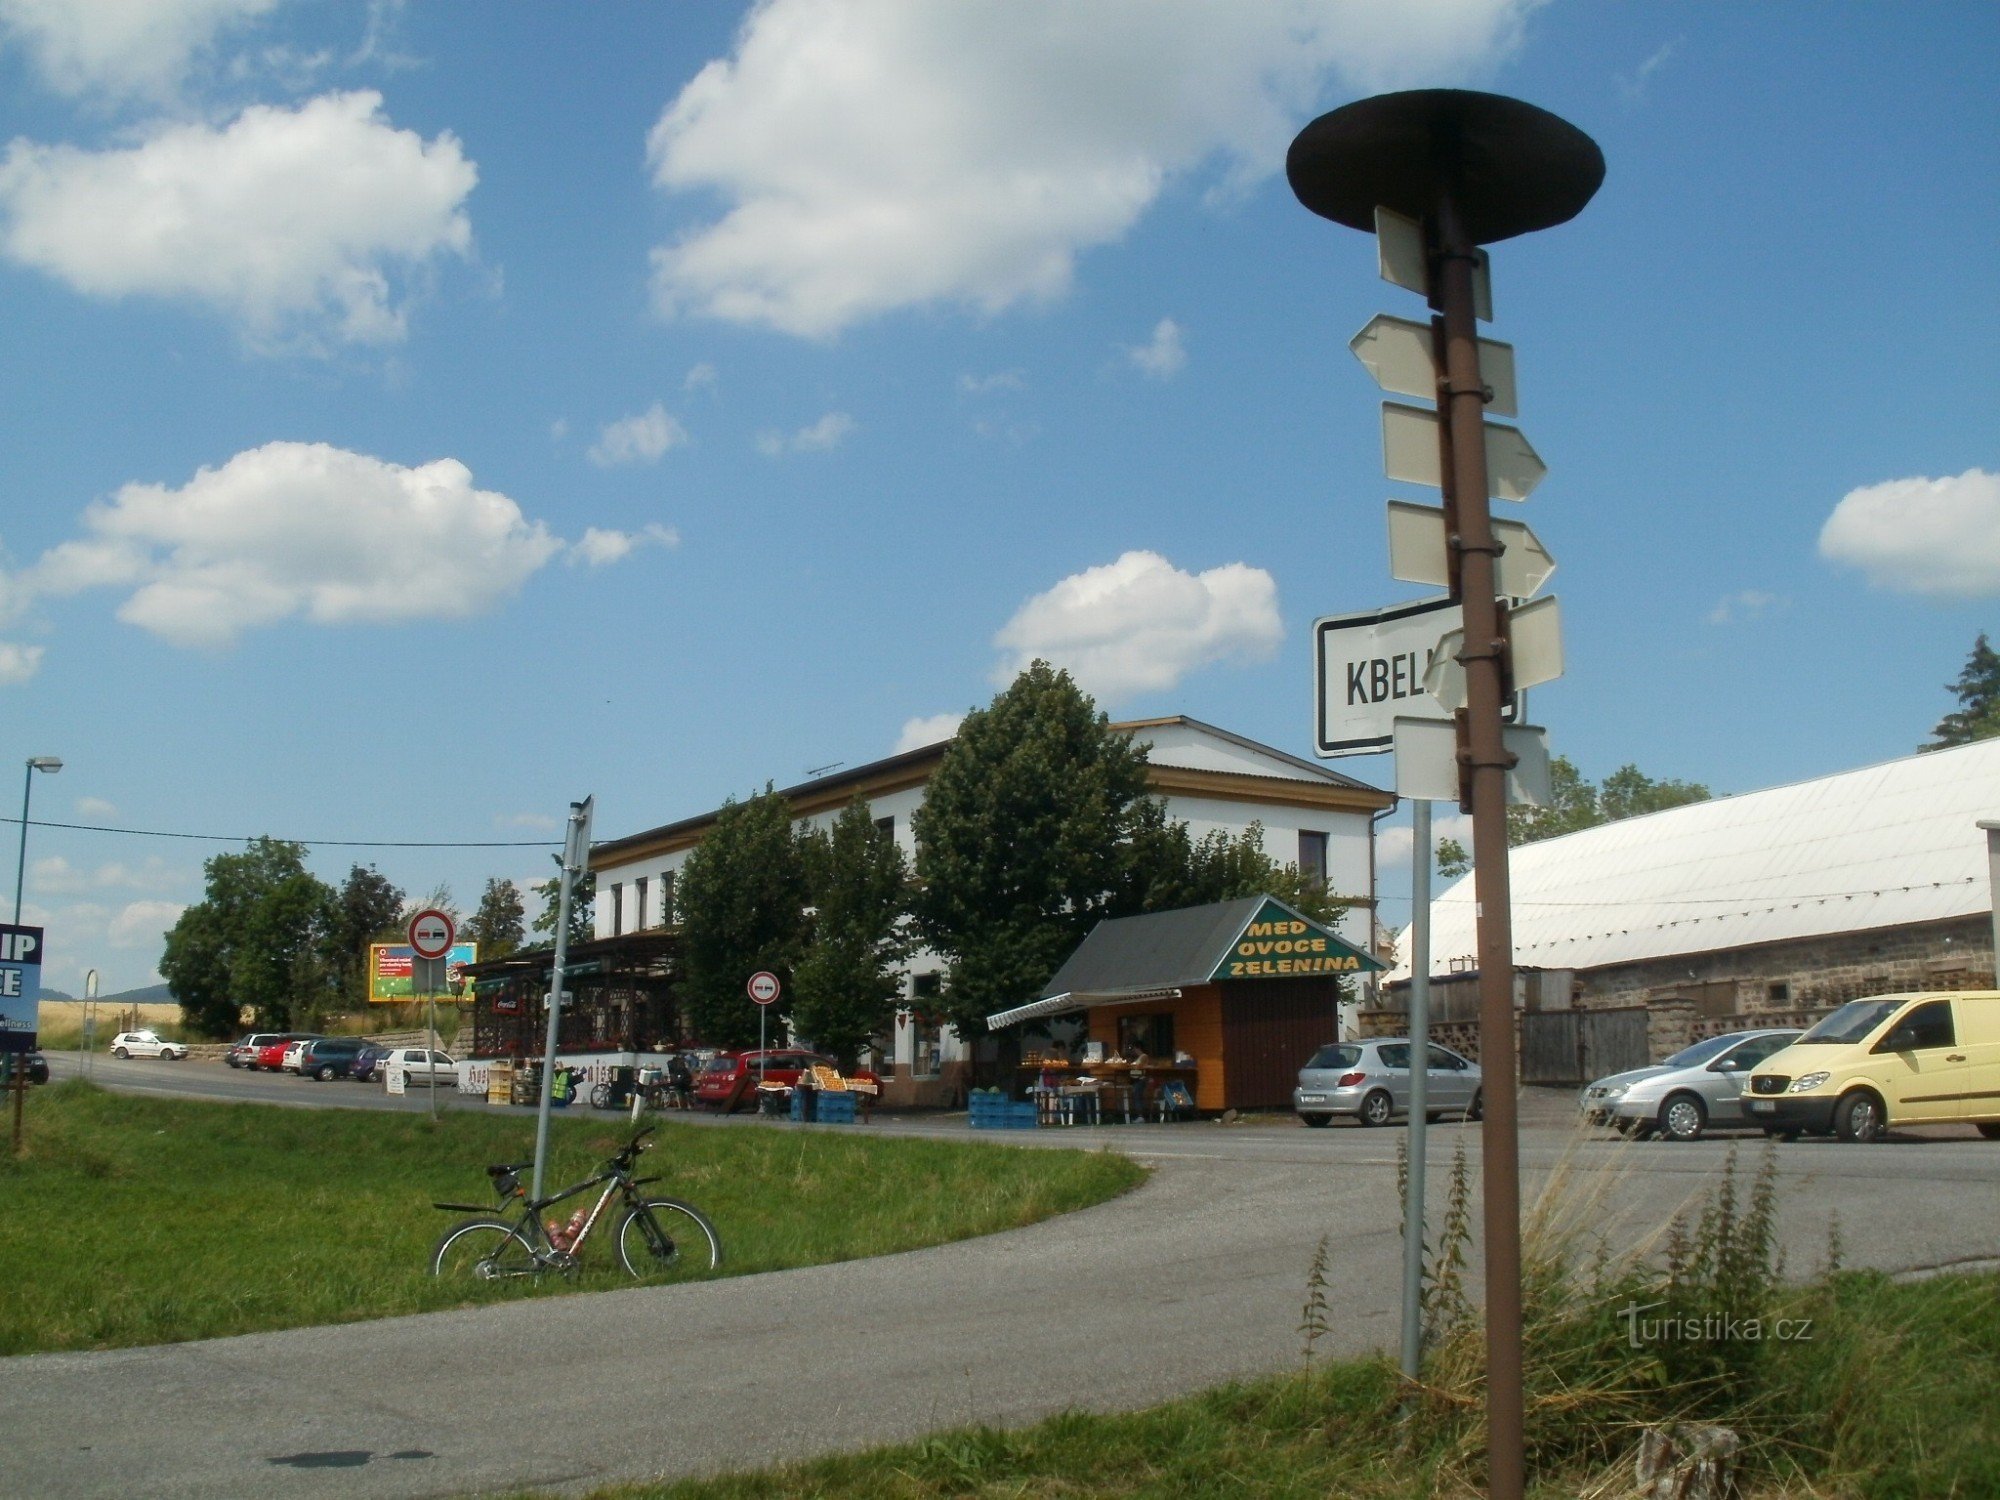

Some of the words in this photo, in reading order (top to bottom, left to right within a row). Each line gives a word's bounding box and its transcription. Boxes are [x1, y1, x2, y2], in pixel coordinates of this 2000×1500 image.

[1347, 648, 1435, 706] KBEL
[1247, 921, 1307, 937] MED
[1237, 938, 1326, 956] OVOCE
[1230, 956, 1360, 976] ZELENINA
